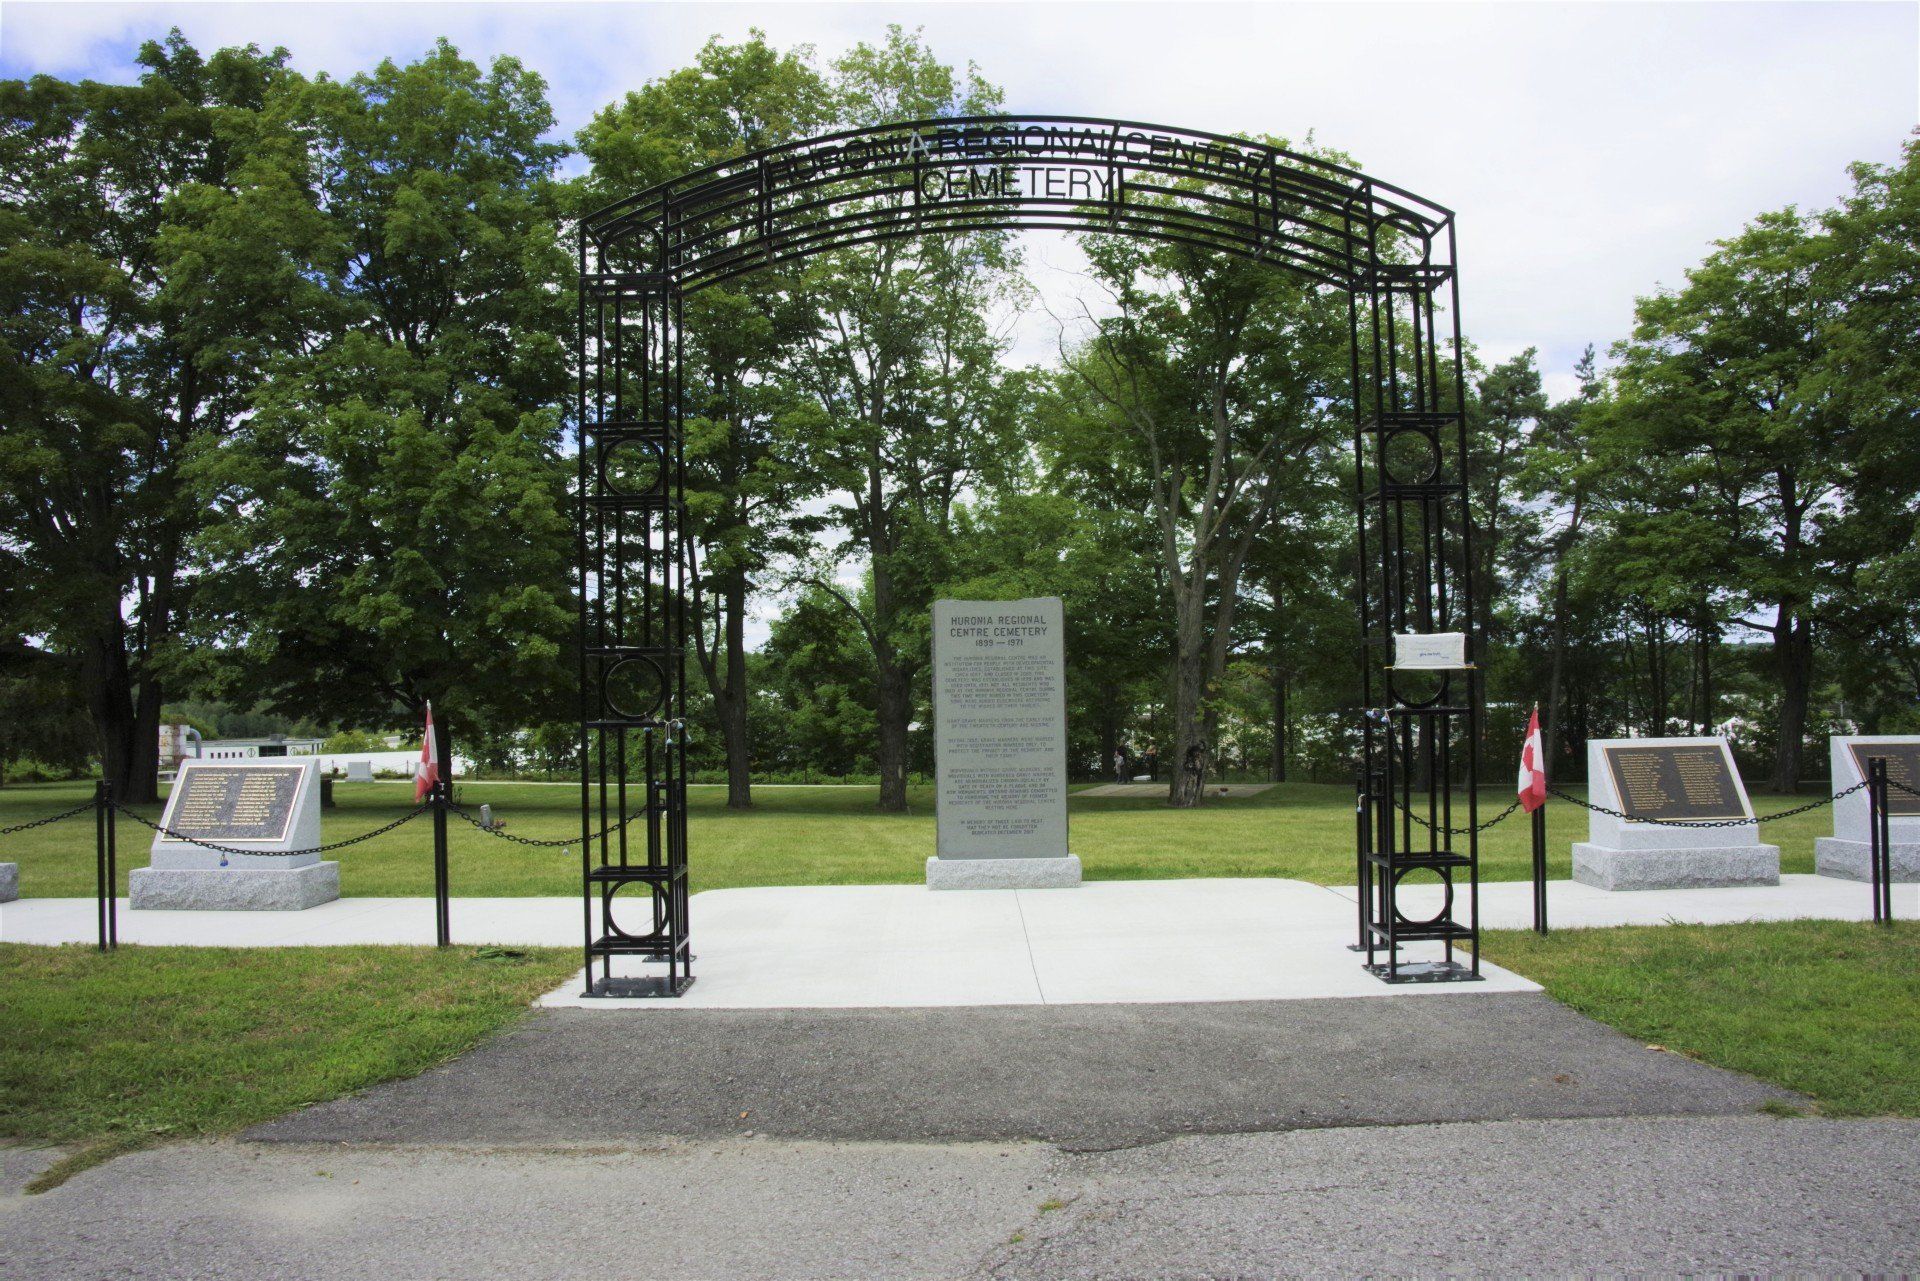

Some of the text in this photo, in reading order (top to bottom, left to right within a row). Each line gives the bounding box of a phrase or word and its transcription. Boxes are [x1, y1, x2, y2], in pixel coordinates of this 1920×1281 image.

[937, 126, 1117, 157] REGIONAL
[1123, 132, 1271, 180] CENTRE
[921, 167, 1116, 199] CEMETERY
[951, 615, 1047, 625] HURONIA REGIONAL
[950, 626, 1048, 637] CENTRE CEMETERY
[975, 639, 994, 647] 1899
[1007, 638, 1023, 646] 1971
